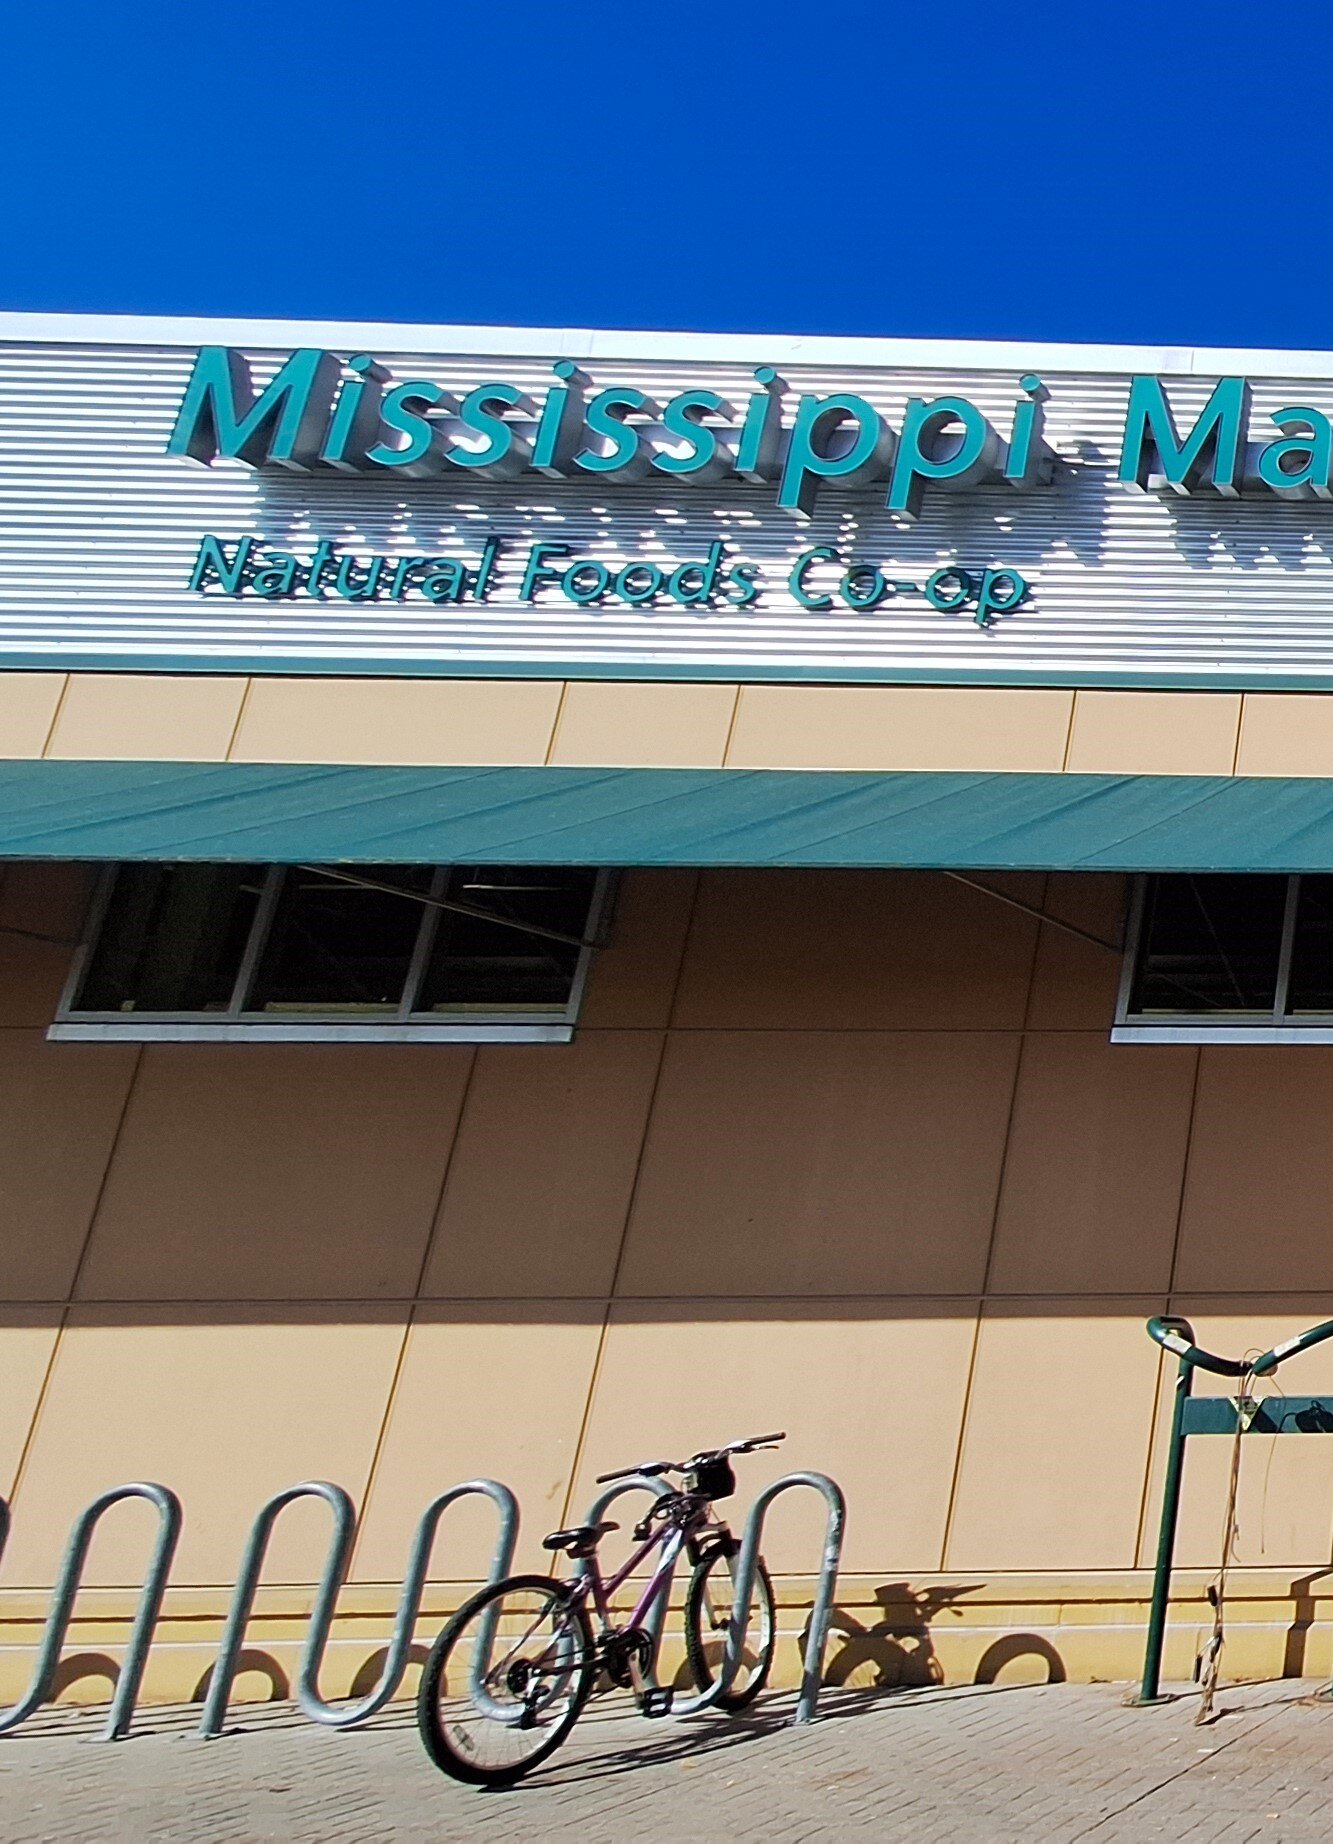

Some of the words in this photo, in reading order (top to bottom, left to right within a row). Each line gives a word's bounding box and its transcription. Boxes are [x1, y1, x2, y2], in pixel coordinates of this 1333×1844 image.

[166, 345, 1043, 514] Mississippi
[188, 534, 498, 601] Natural
[519, 541, 760, 605] Foods
[788, 546, 1029, 625] Co-op
